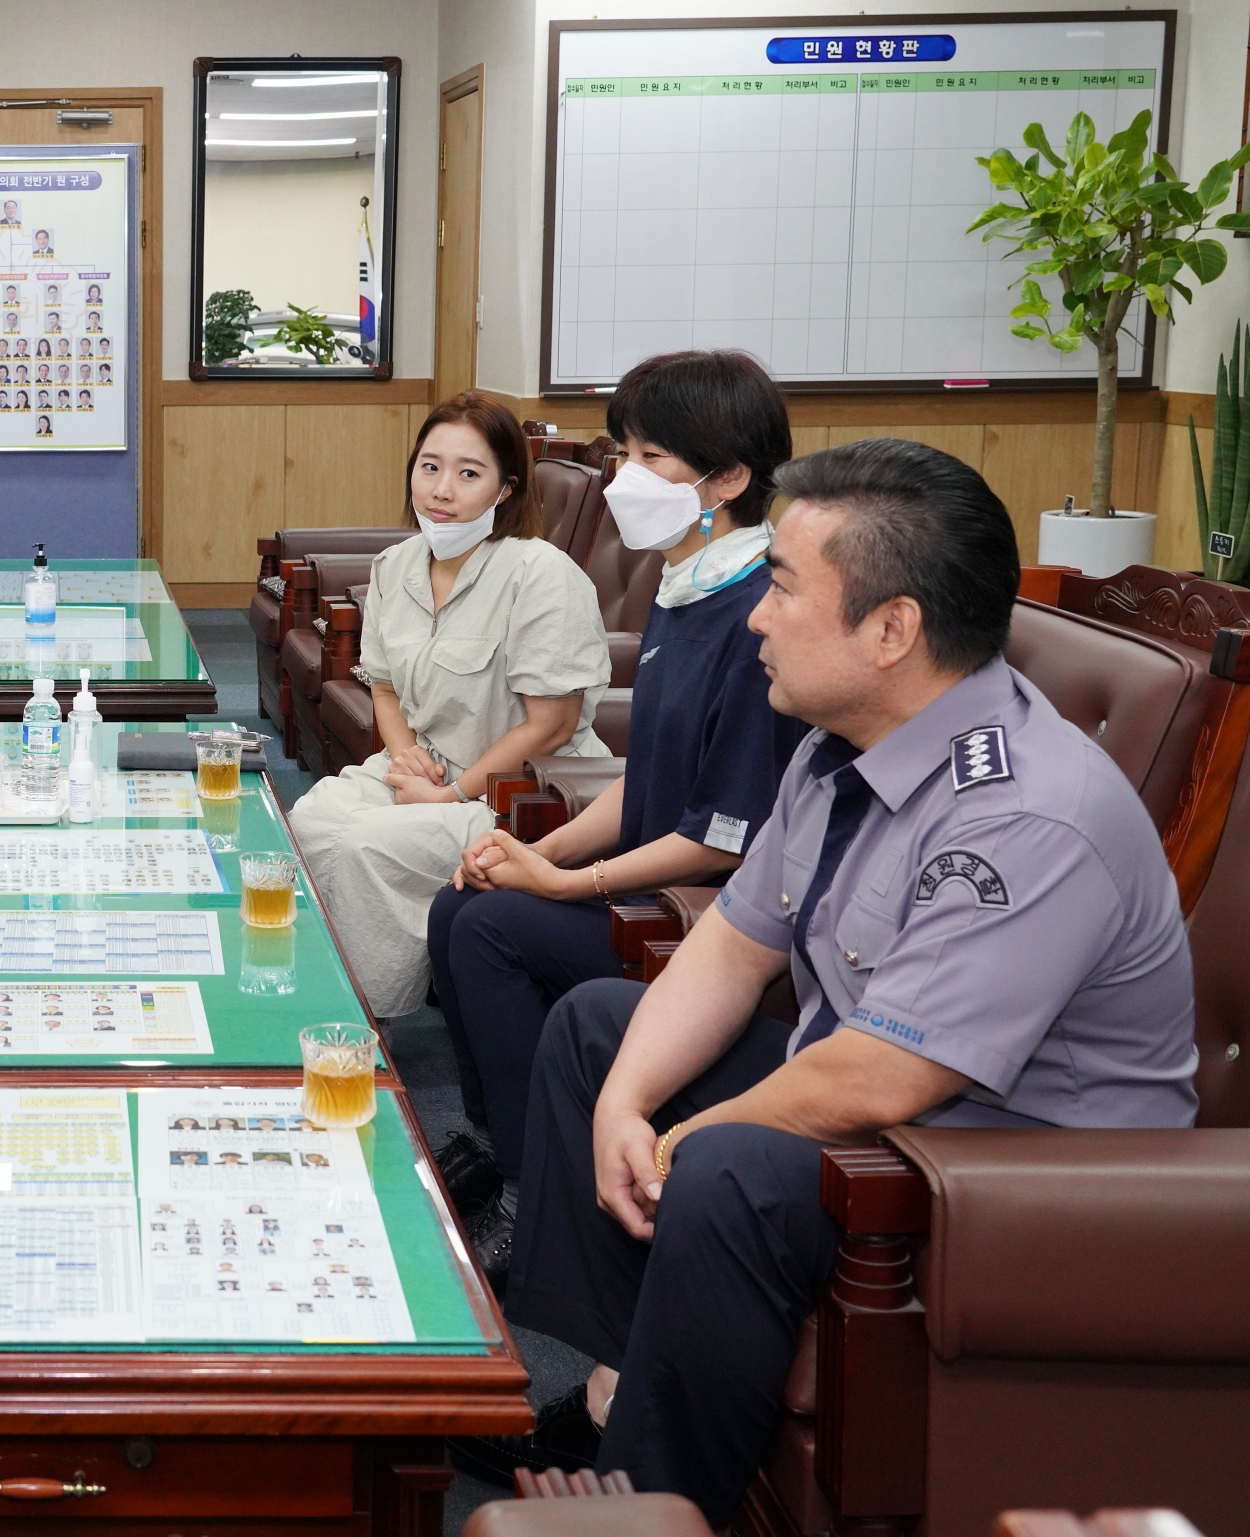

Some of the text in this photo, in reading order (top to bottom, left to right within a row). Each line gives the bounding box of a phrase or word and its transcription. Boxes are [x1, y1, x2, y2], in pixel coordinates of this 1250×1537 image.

[803, 39, 920, 60] 민원 현황판
[590, 83, 615, 93] 민원인
[785, 80, 818, 89] 처리부서
[830, 80, 847, 89] 비고
[885, 79, 911, 88] 민원인
[1082, 76, 1116, 85] 처리부서
[1128, 75, 1145, 84] 비고
[22, 175, 52, 187] 전반기
[56, 175, 66, 187] 원
[69, 175, 89, 186] 구성
[716, 812, 741, 828] EVERLAST
[920, 855, 1001, 897] 청원경찰
